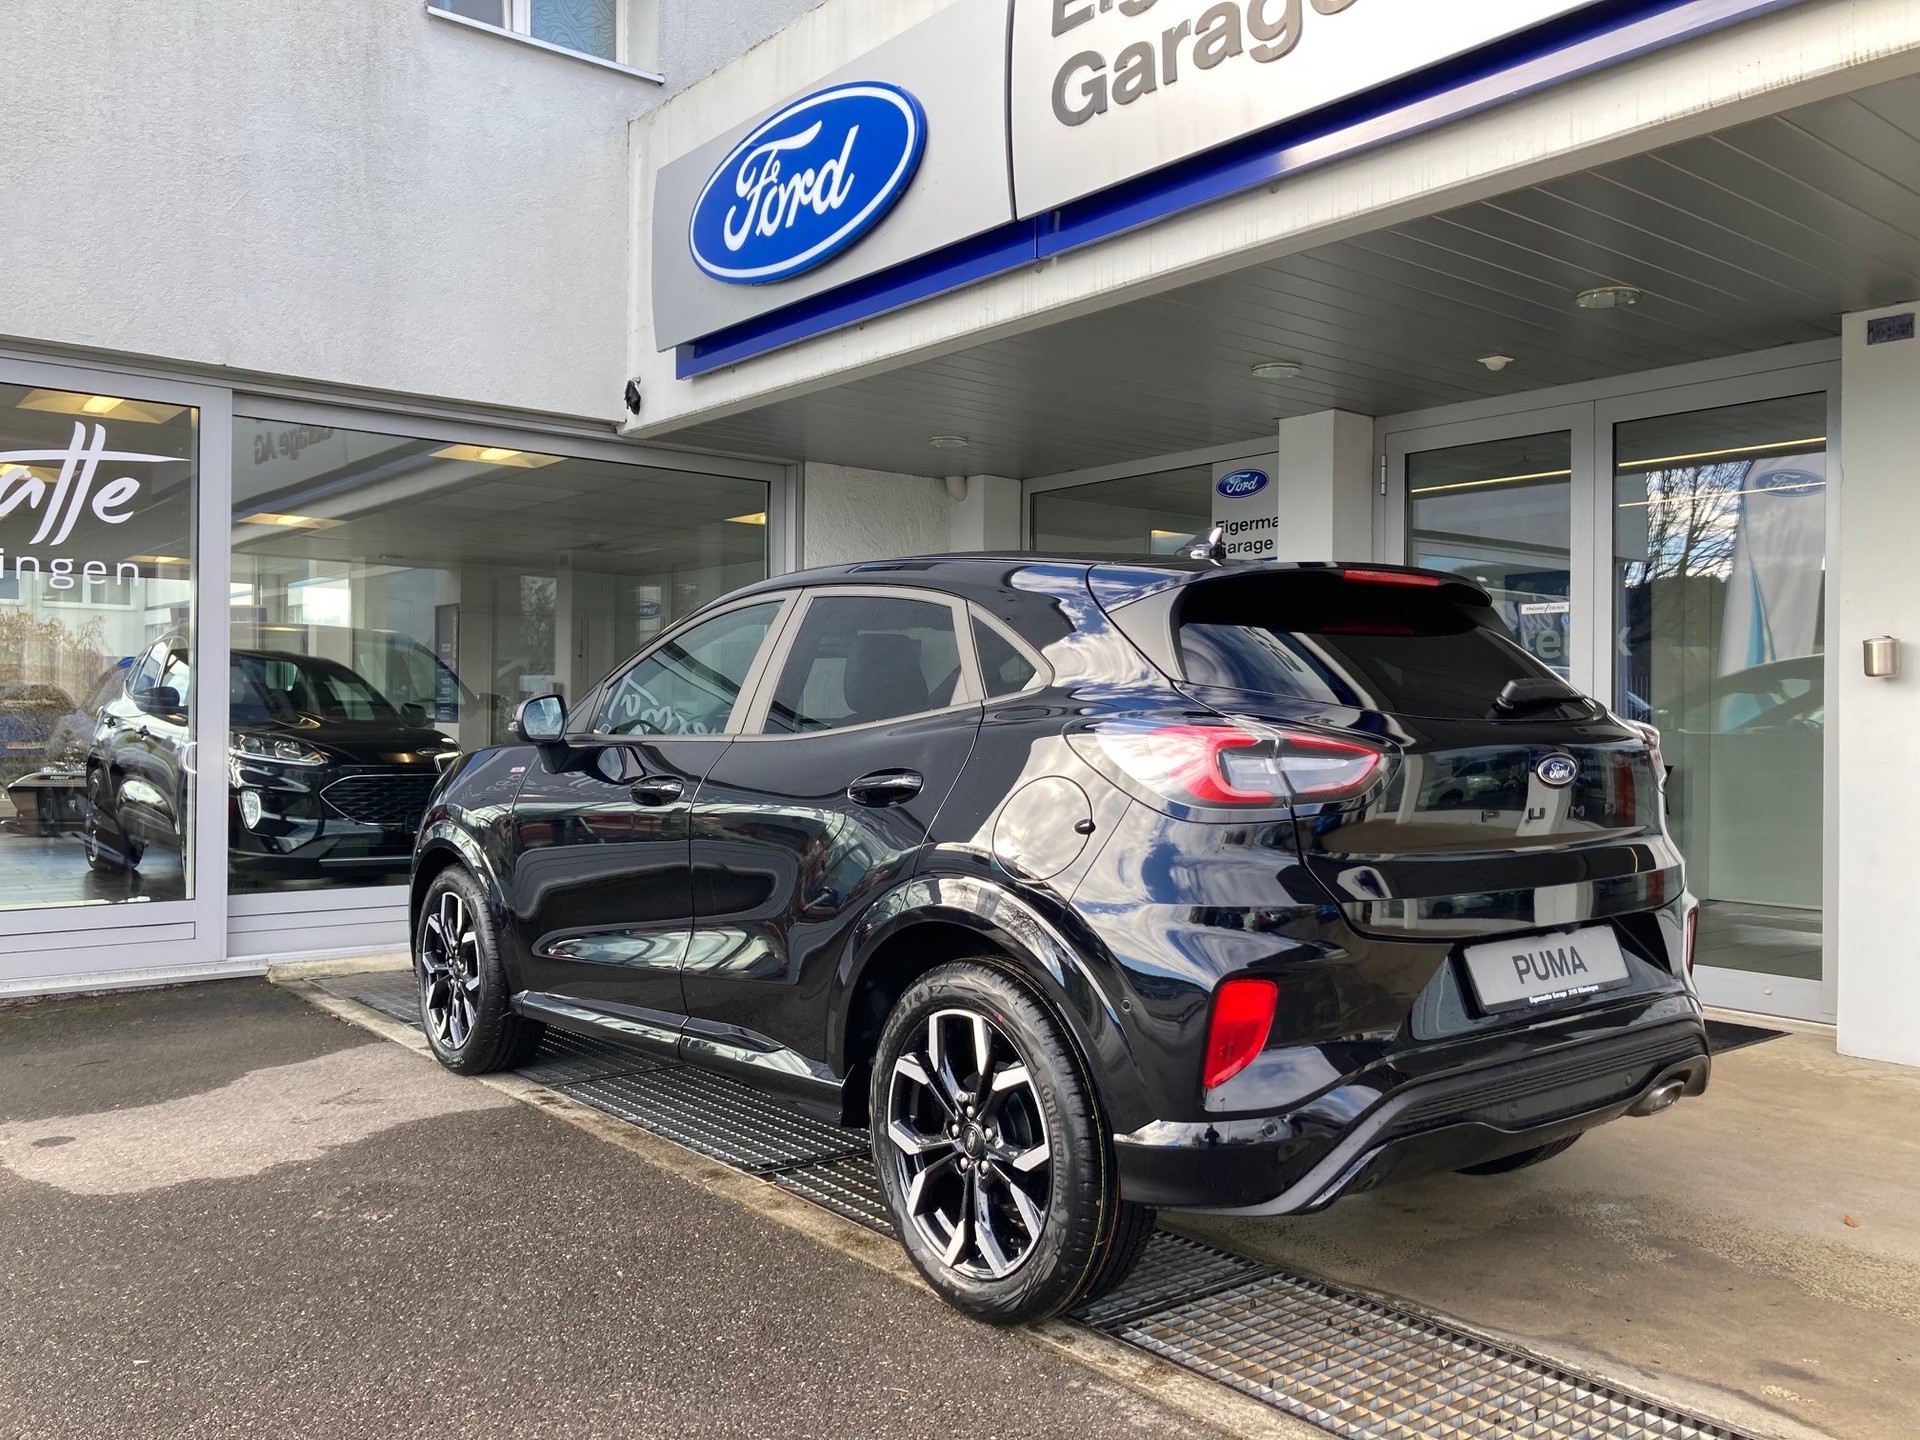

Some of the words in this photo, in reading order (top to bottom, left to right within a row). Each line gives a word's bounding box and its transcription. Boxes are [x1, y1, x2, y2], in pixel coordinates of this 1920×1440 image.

[1052, 0, 1359, 127] Garag
[724, 119, 860, 251] Ford
[1226, 473, 1259, 493] Ford
[1766, 473, 1812, 493] Ford
[1549, 763, 1570, 778] Ford
[1481, 803, 1616, 823] PUMA
[1511, 945, 1588, 984] PUMA
